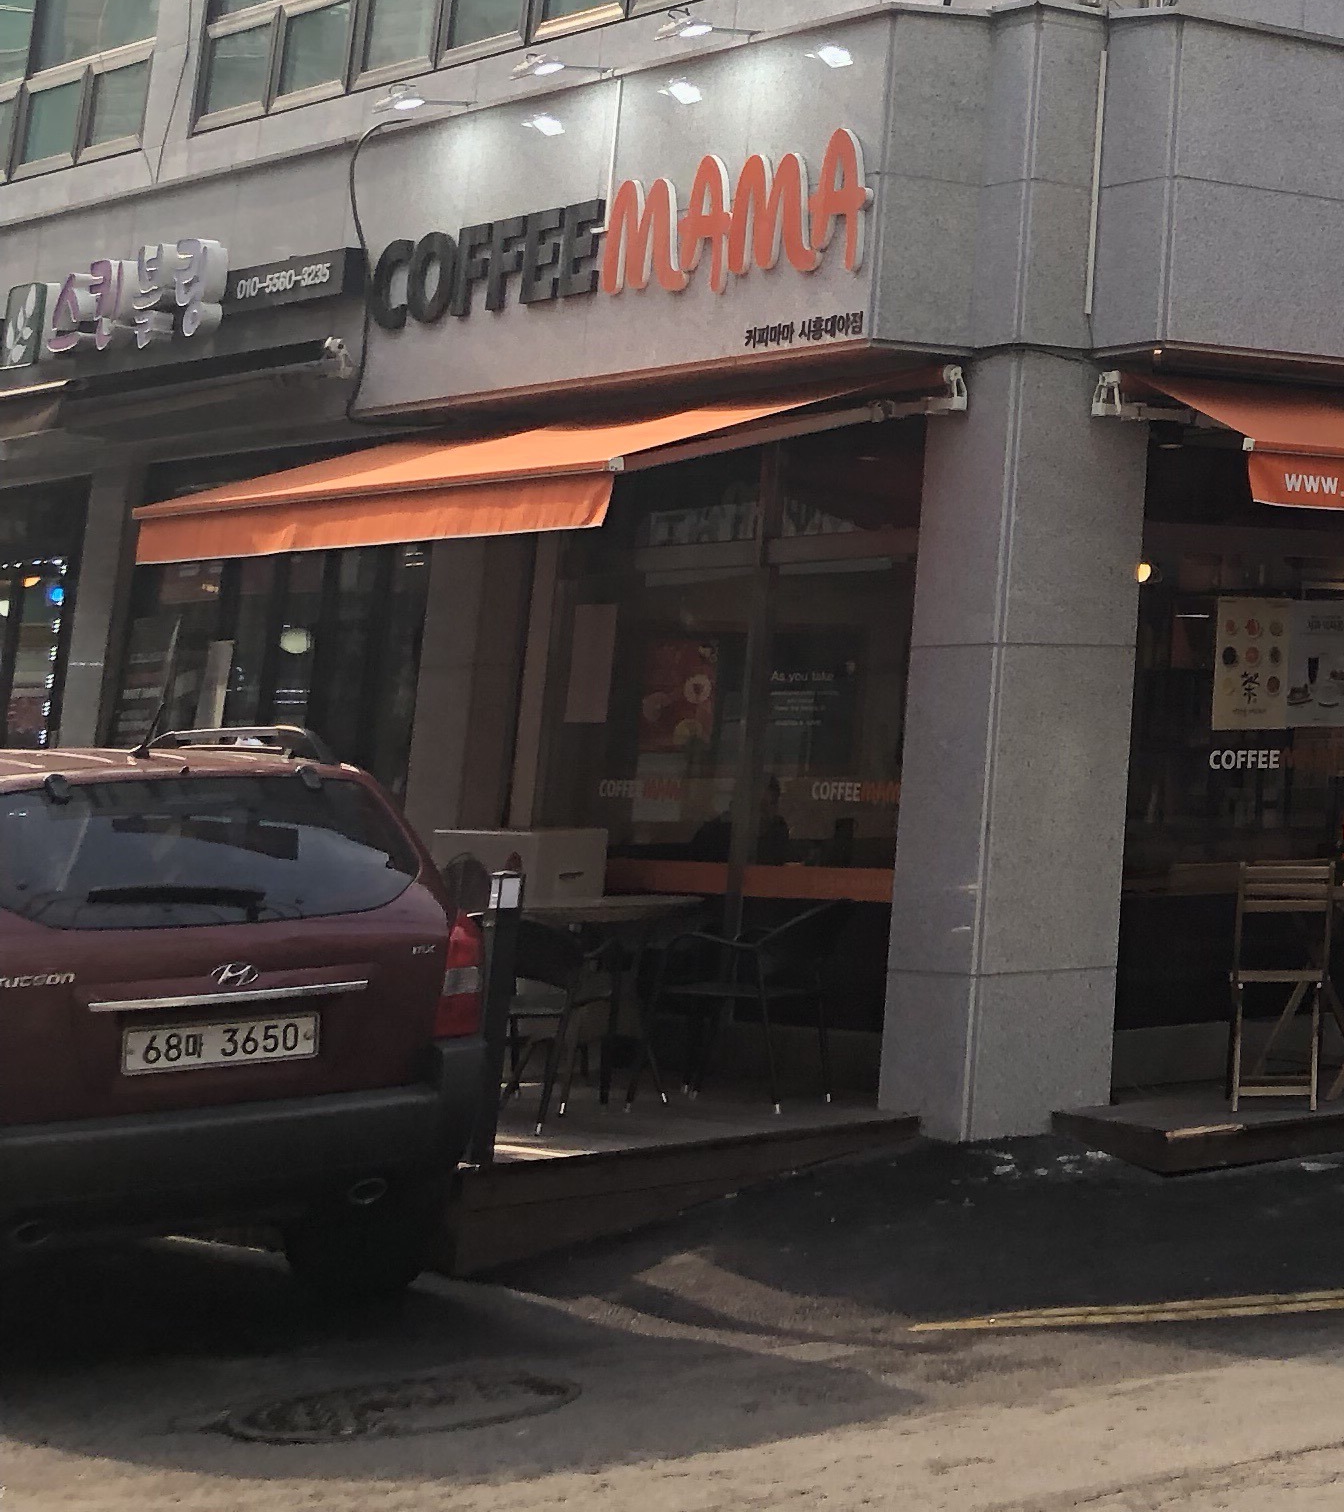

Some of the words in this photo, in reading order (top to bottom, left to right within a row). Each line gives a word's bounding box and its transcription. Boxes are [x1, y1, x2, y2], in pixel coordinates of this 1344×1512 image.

[372, 198, 606, 330] COFFEE
[602, 128, 874, 295] MAMA
[744, 320, 796, 349] 커피마마
[1209, 749, 1280, 770] COFFEE
[811, 782, 861, 802] COFFEE
[143, 1033, 203, 1065] 68마
[220, 1022, 299, 1057] 3650
